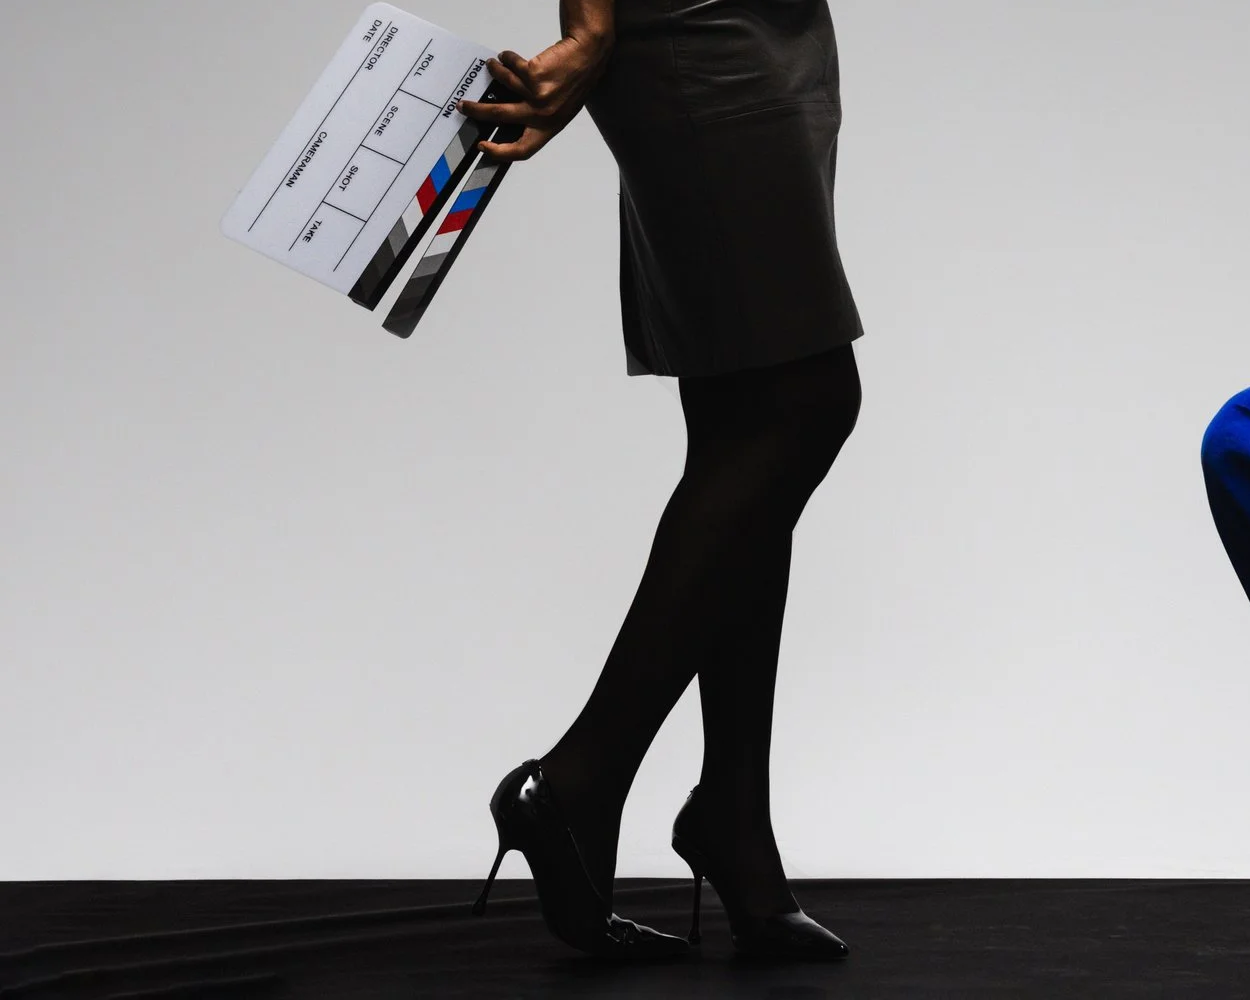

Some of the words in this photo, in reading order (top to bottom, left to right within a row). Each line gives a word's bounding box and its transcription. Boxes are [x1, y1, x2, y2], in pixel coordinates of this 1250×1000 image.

[363, 18, 382, 42] DATE
[364, 26, 399, 72] DIRECTOR
[414, 53, 434, 77] ROLL
[442, 58, 486, 118] PRODUCTION
[374, 105, 399, 136] SCENE
[285, 131, 328, 188] CAMERAMAN
[338, 164, 359, 192] SHOT
[302, 219, 323, 244] TAKE
